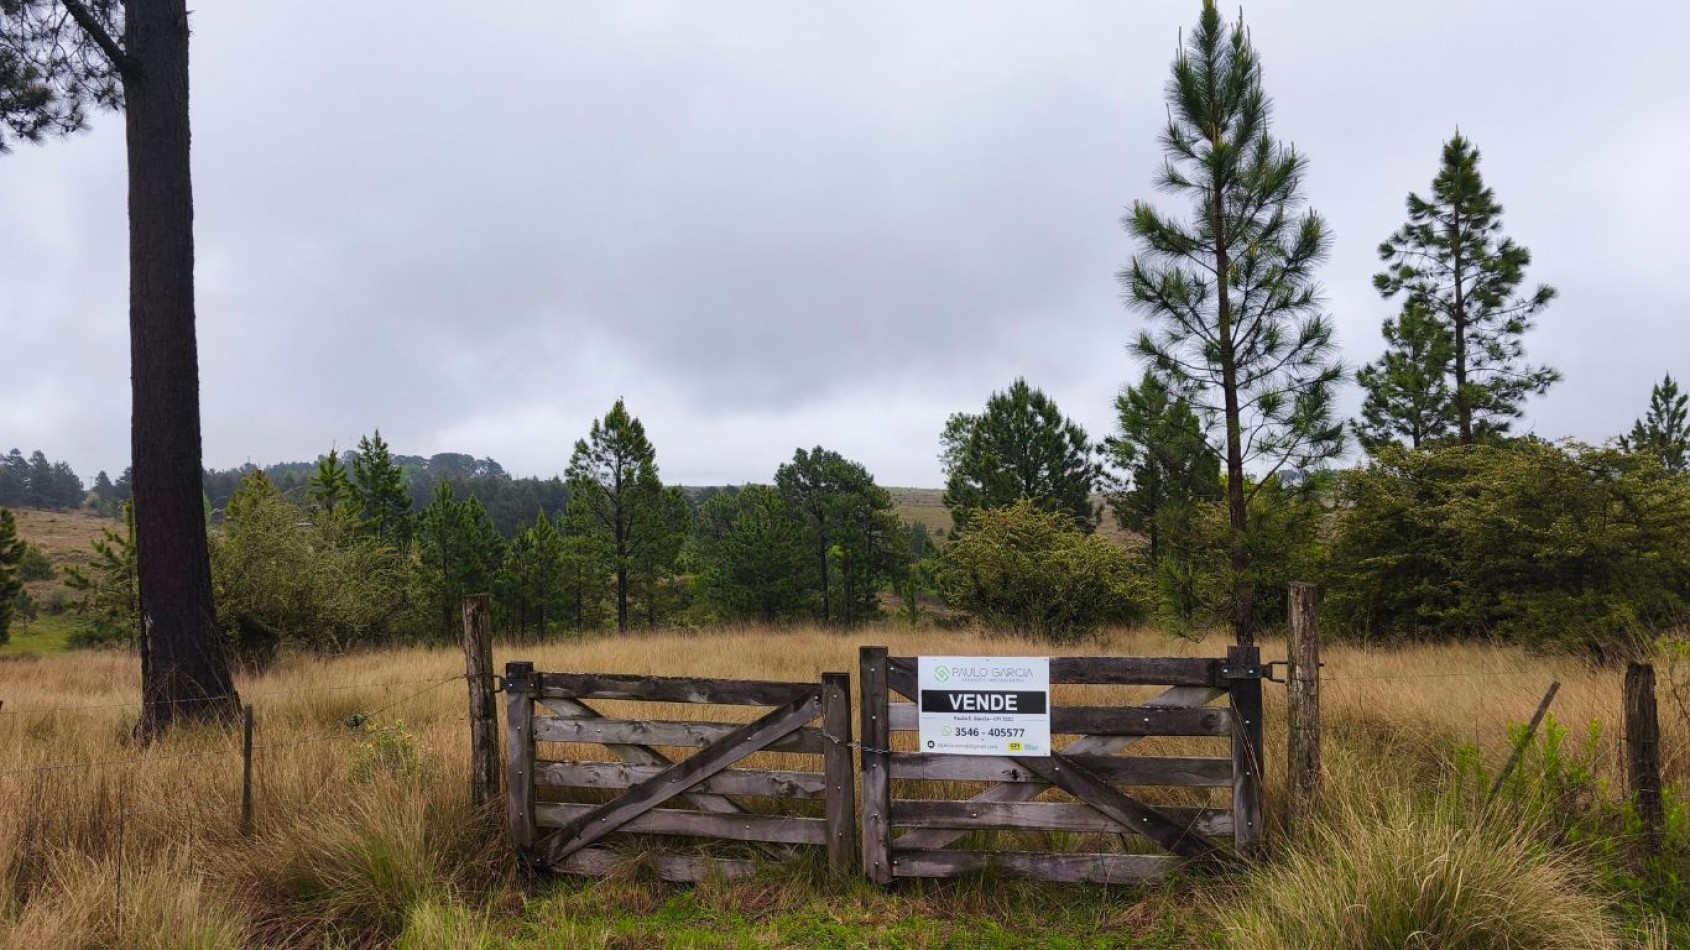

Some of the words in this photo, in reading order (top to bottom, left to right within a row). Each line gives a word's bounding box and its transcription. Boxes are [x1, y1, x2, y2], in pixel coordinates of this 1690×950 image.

[952, 667, 988, 678] PAULO
[991, 667, 1034, 678] GARCIA
[949, 693, 1018, 711] VENDE
[955, 726, 980, 737] 3546
[988, 727, 1025, 738] 405577
